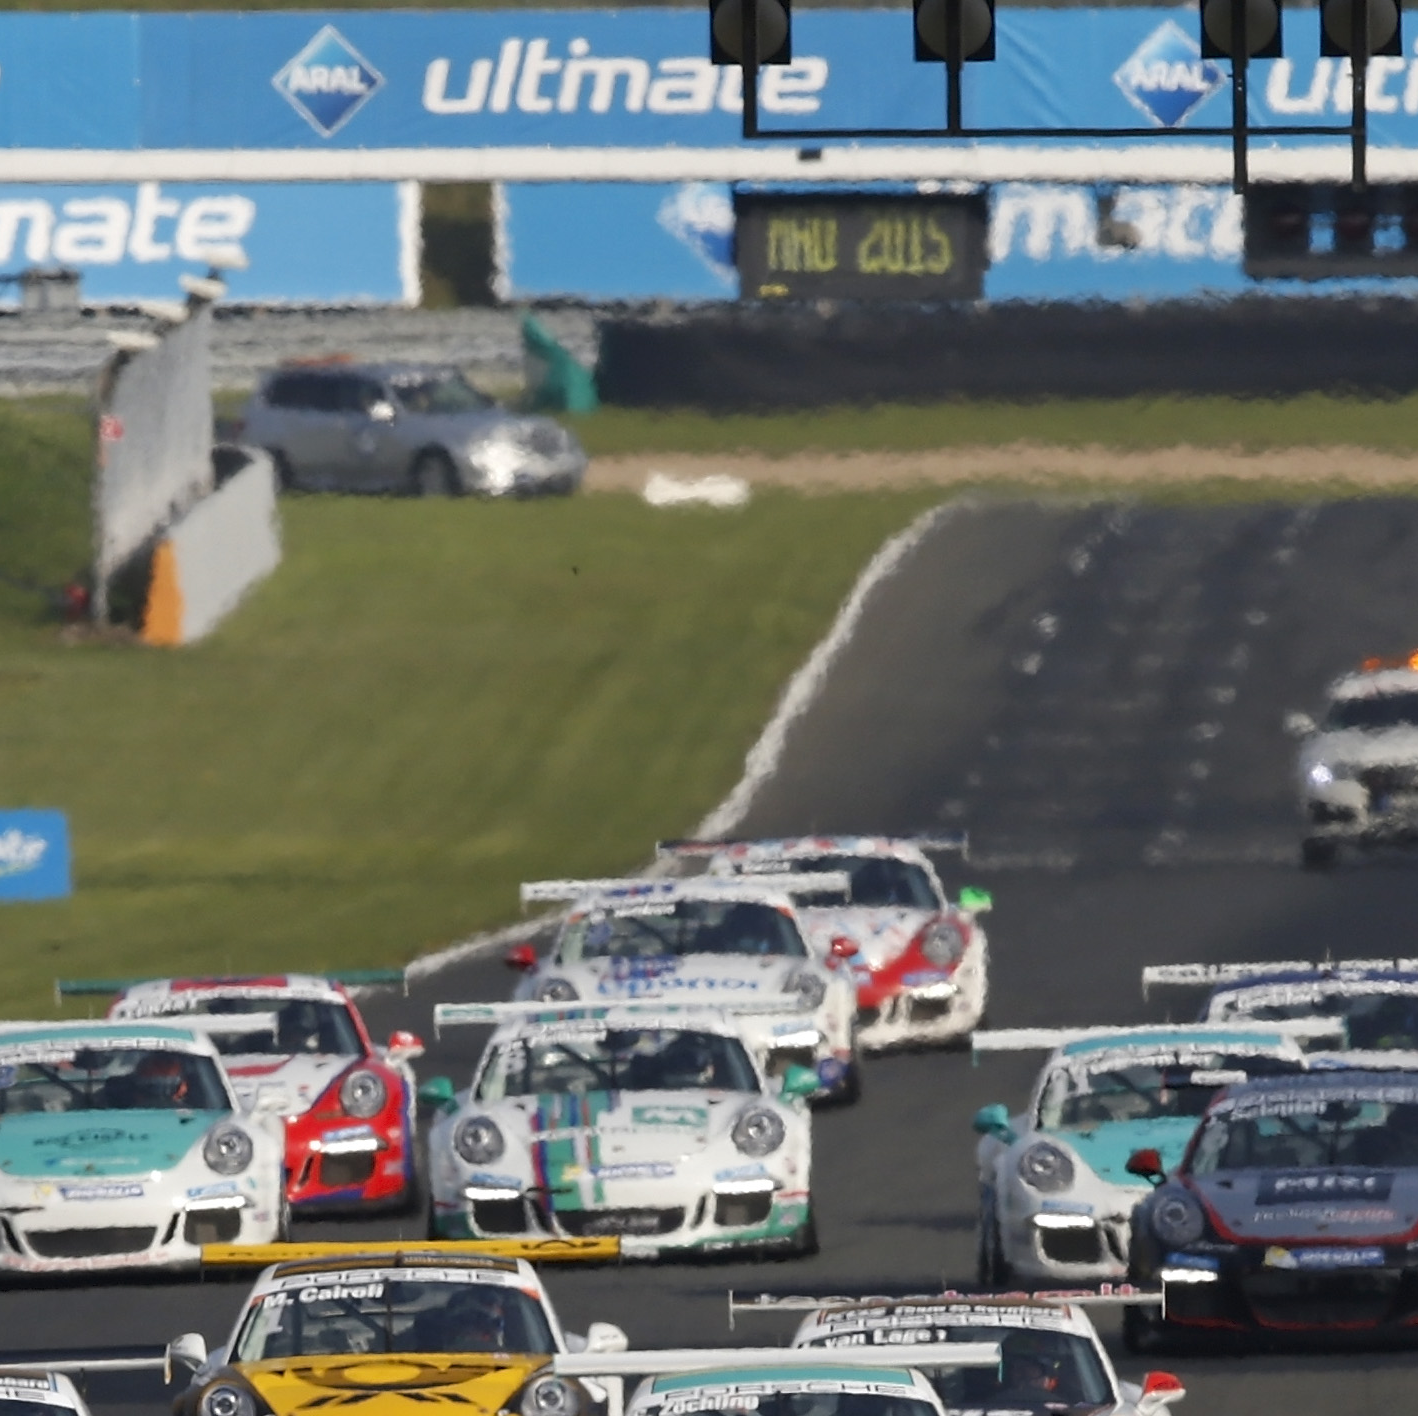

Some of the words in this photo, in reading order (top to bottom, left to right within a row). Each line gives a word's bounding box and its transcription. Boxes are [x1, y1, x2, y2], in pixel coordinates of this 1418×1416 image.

[289, 66, 365, 95] ARAL
[425, 39, 828, 113] ultimate
[1129, 60, 1209, 89] ARAL
[263, 1292, 294, 1310] M.
[298, 1283, 385, 1304] Cairoli
